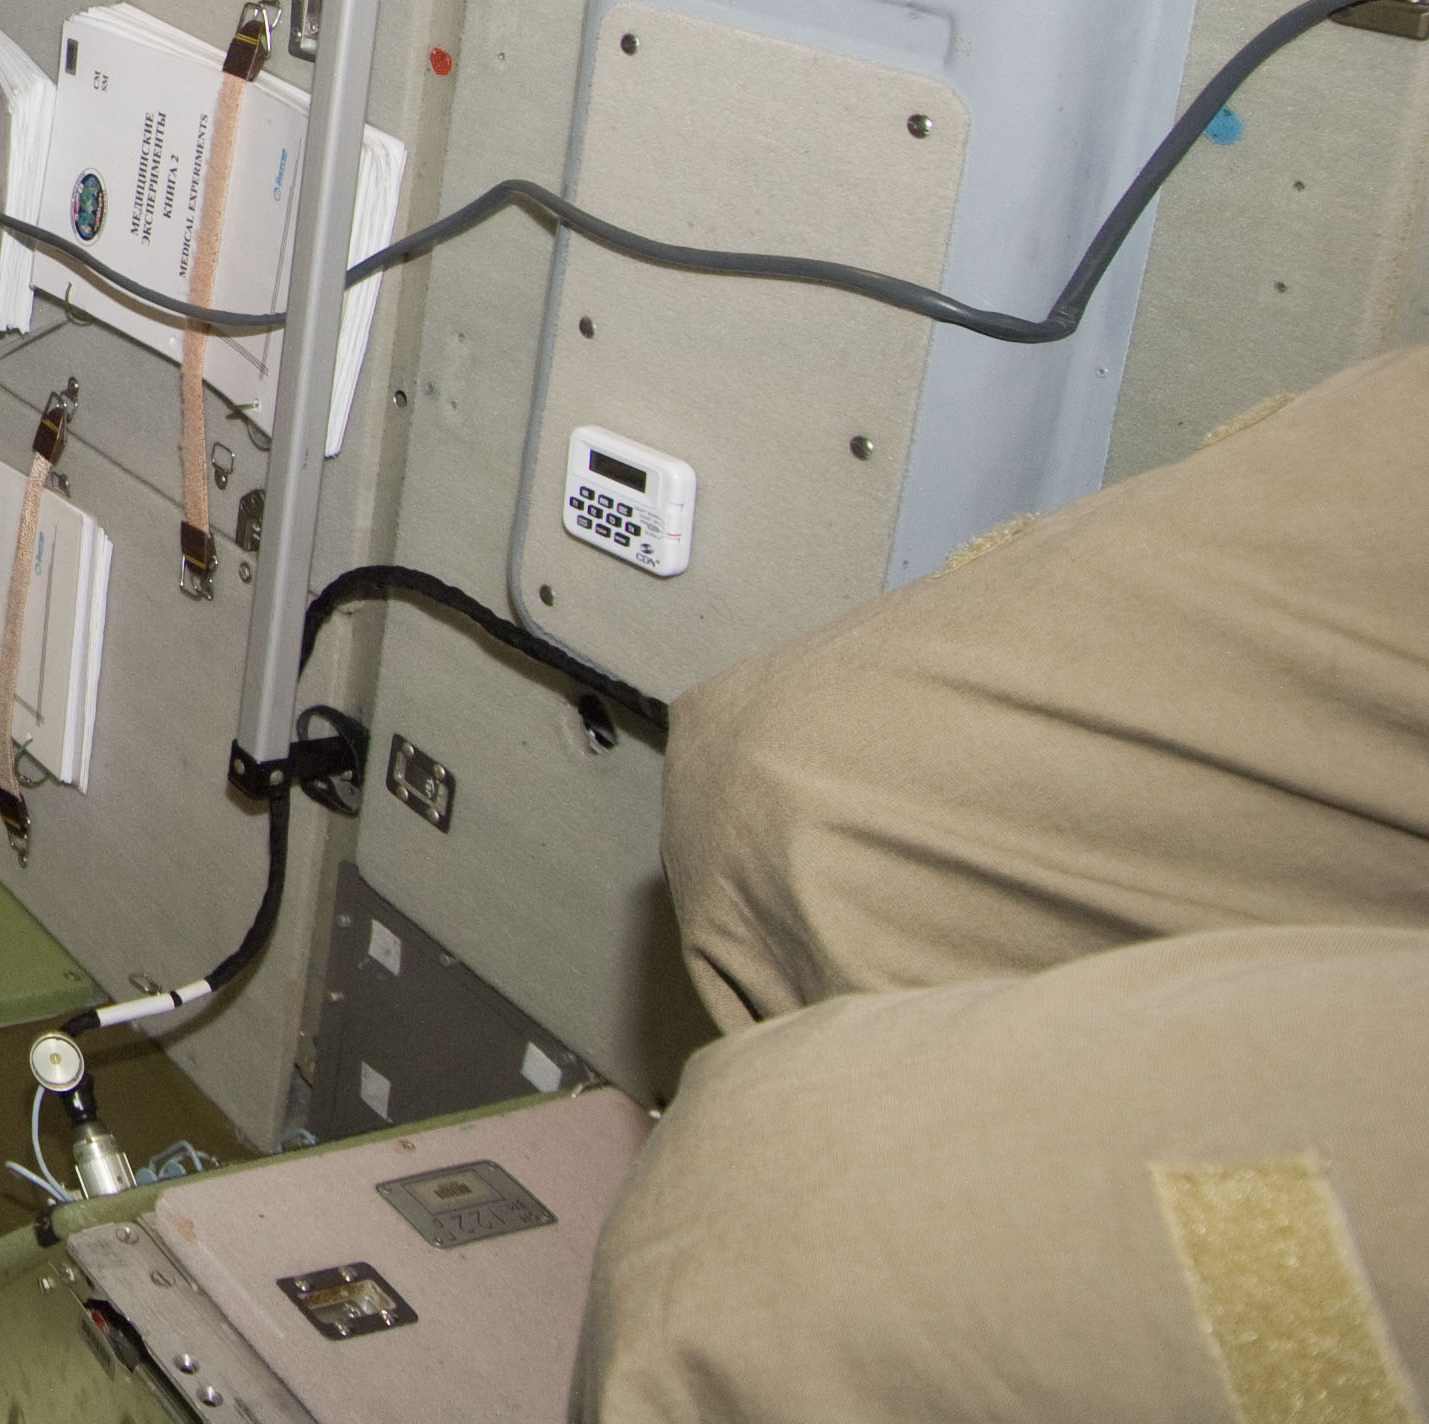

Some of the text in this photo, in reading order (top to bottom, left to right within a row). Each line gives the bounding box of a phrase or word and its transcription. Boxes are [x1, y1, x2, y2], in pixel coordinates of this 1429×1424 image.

[101, 74, 110, 93] SM
[129, 111, 154, 236] МЕДИЦИНСКИЕ
[140, 111, 166, 247] ЭКСПЕРИМЕНТЫ
[163, 153, 179, 219] КНИГА 2
[178, 112, 209, 279] MEDICAL EXPERIMENTS
